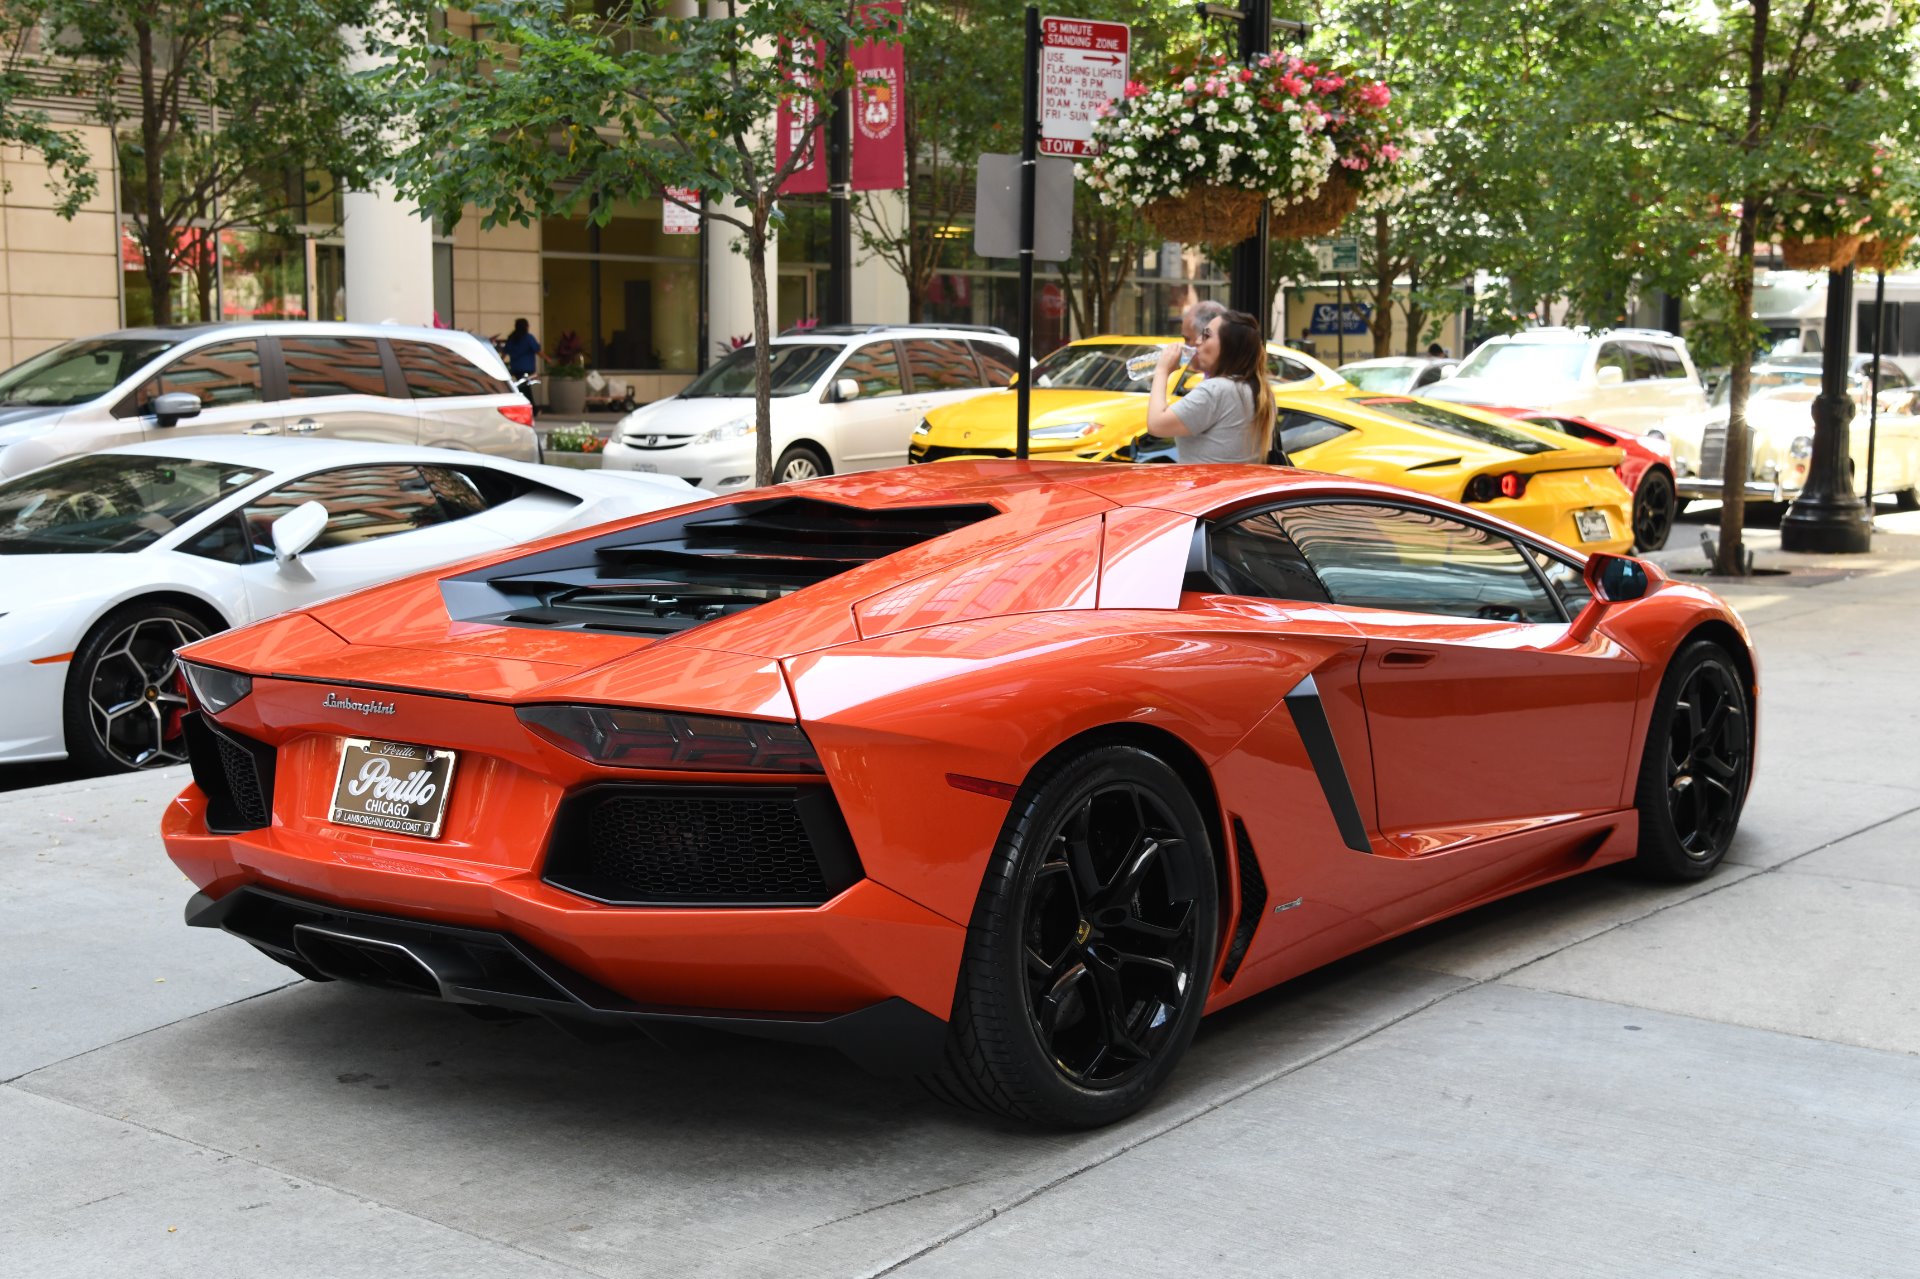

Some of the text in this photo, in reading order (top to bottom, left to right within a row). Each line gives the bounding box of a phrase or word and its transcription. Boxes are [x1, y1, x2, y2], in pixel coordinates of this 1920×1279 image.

[1047, 22, 1093, 36] 15 MINUTE
[1047, 34, 1119, 50] STANDING ZONE
[1047, 52, 1065, 62] USE
[1047, 64, 1122, 79] FLASHING LIGHTS
[1047, 75, 1056, 84] 10
[1058, 76, 1072, 84] AM
[1081, 78, 1087, 87] 8
[1090, 78, 1104, 87] PM
[1046, 86, 1066, 96] MON
[1077, 89, 1107, 100] THURS
[1046, 98, 1055, 107] 10
[1057, 99, 1070, 107] AM
[1080, 101, 1086, 110] 6
[1046, 109, 1061, 119] FRI
[1069, 111, 1089, 120] SUN
[1045, 139, 1075, 153] TOW
[322, 692, 396, 715] Lamborghini
[380, 743, 416, 757] Perillo
[348, 757, 436, 805] Perillo
[365, 798, 410, 817] CHICAGO
[343, 813, 421, 832] LAMBORGHINI GOLD COAST
